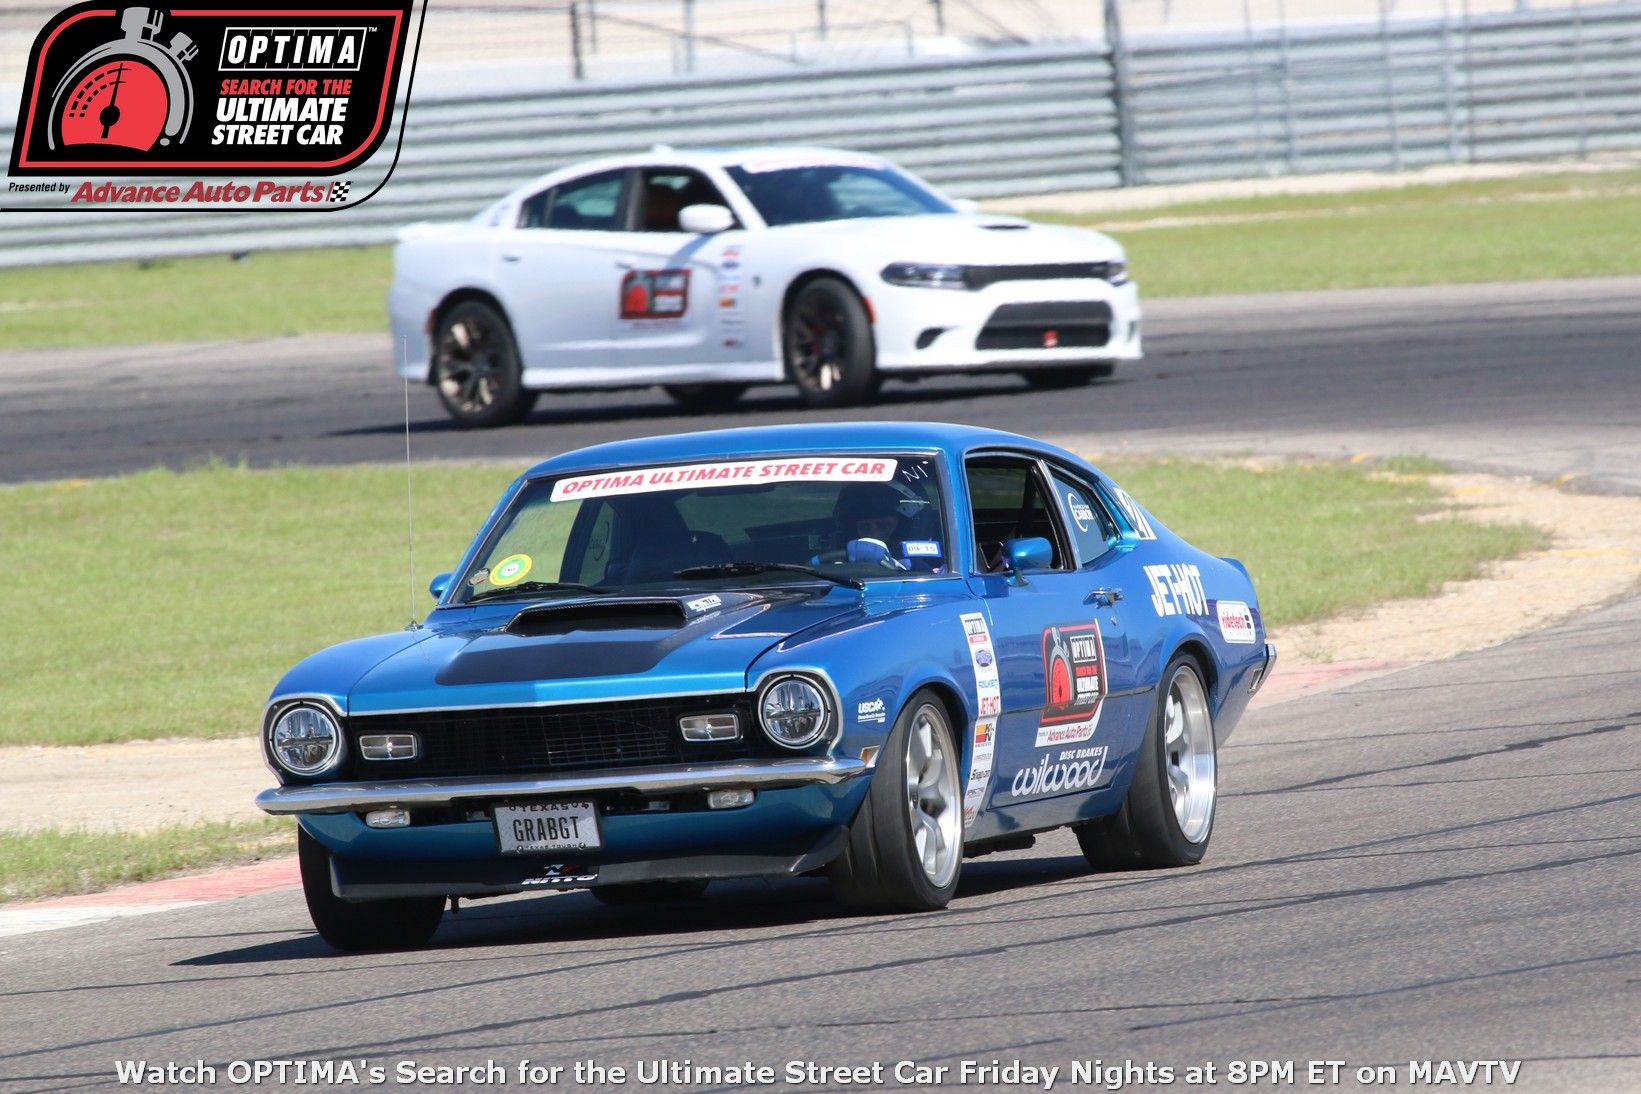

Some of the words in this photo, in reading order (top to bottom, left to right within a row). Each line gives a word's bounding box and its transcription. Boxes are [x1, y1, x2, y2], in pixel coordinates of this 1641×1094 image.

[561, 475, 644, 495] OPTIMA
[649, 466, 754, 485] ULTIMATE
[759, 462, 834, 478] STREET
[836, 462, 886, 476] CAR
[1143, 562, 1210, 618] JET-HOT
[1060, 750, 1076, 760] DISC
[1076, 746, 1104, 759] BRAKES
[1011, 745, 1109, 797] wilwood
[520, 802, 569, 812] TEXAS
[512, 816, 579, 842] GRABGT
